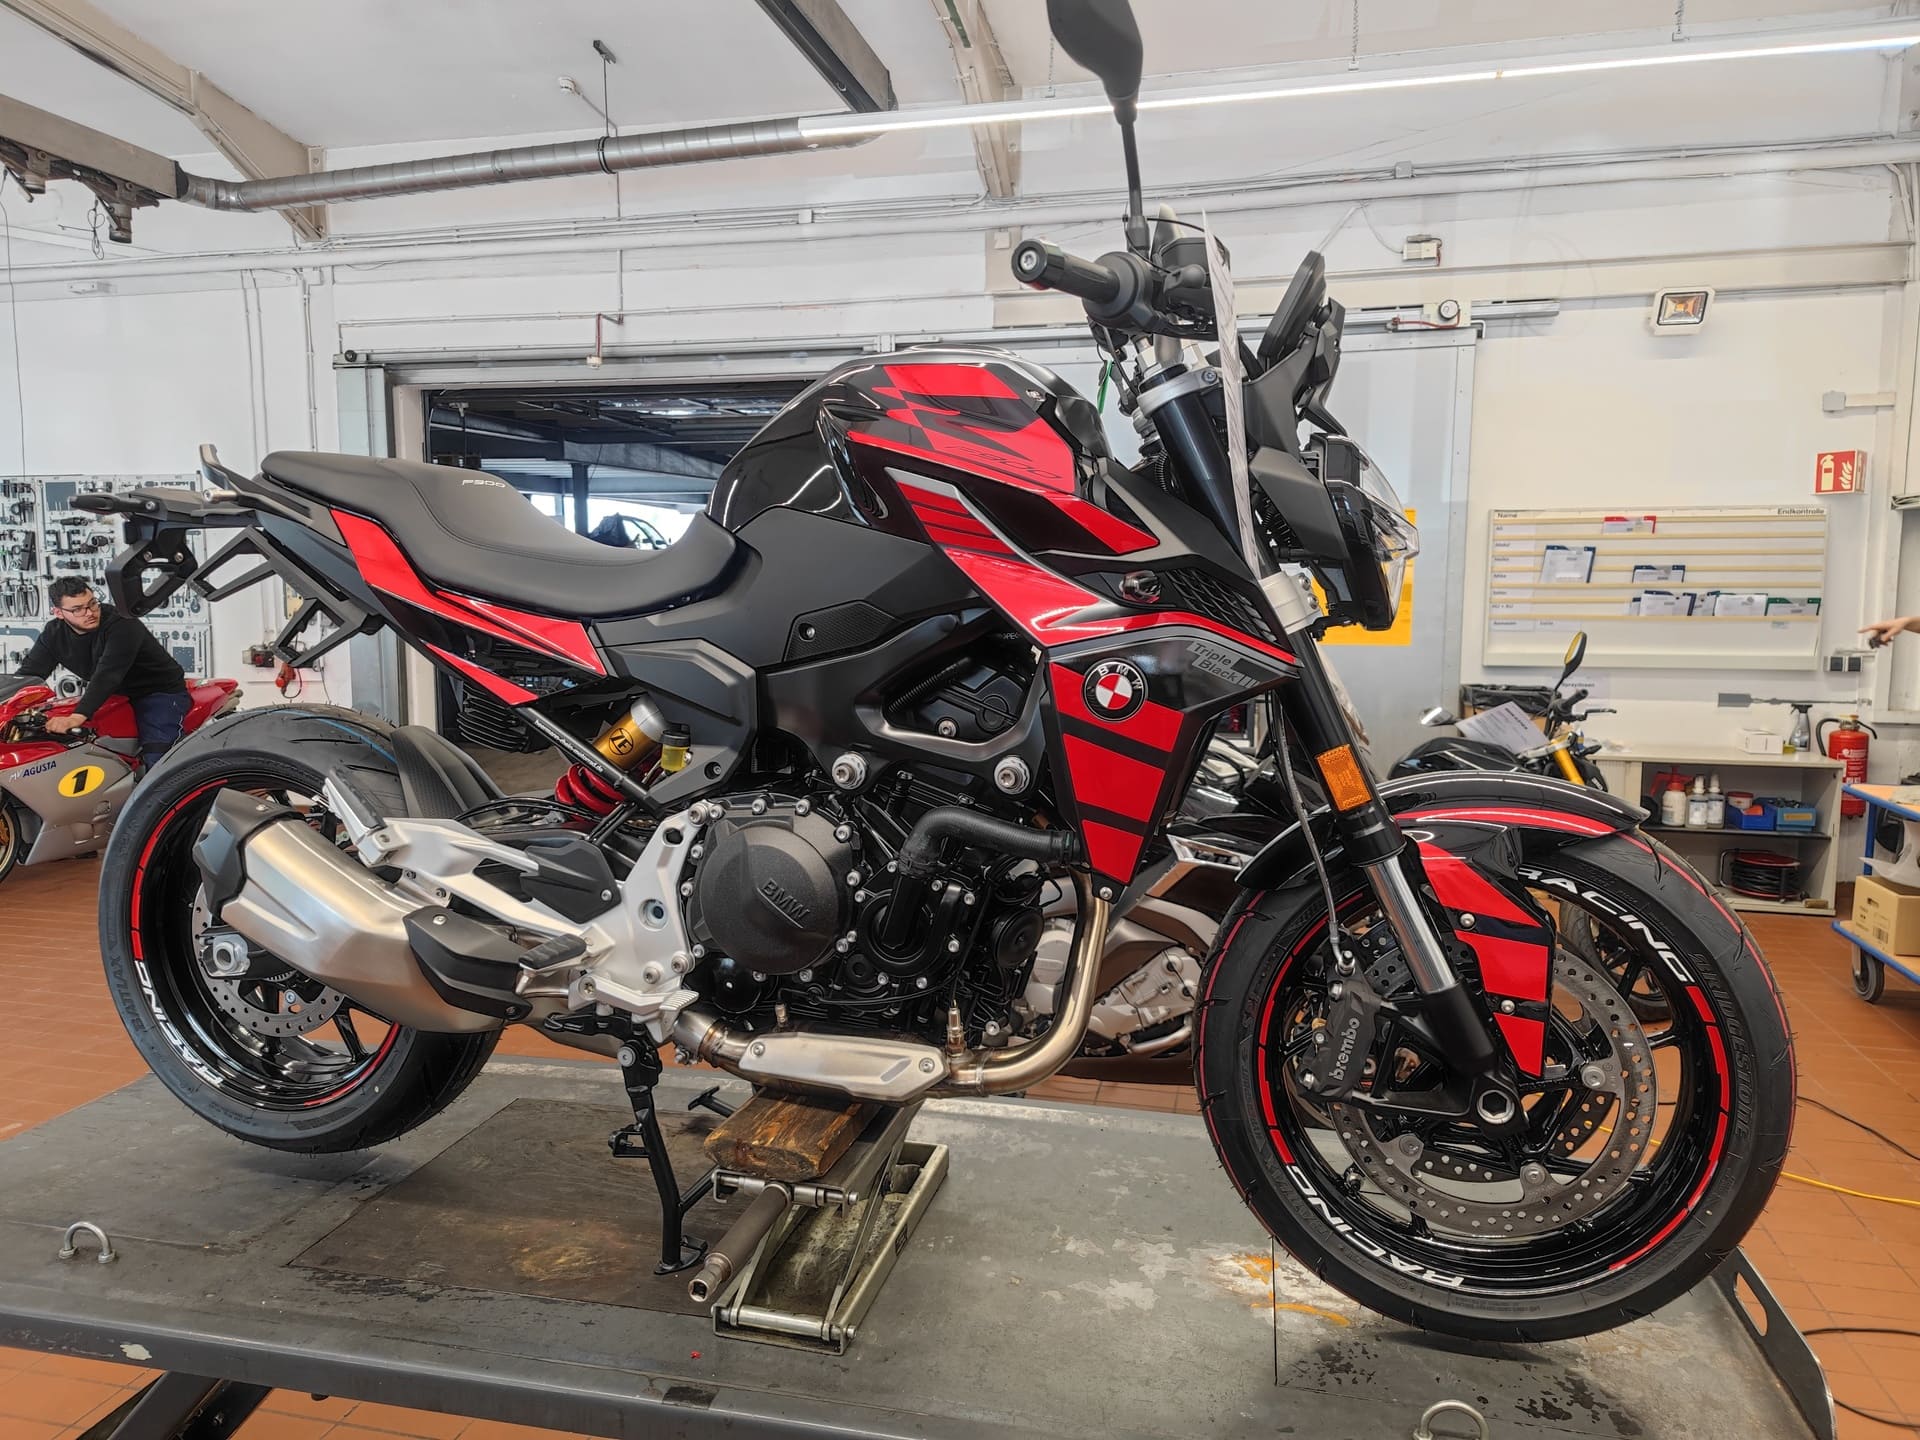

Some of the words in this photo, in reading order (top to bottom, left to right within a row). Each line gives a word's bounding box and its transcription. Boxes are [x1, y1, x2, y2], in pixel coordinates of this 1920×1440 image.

[461, 479, 506, 488] F900
[1194, 644, 1233, 667] Triple
[1097, 663, 1144, 690] BMW
[1199, 660, 1241, 683] Black
[22, 760, 57, 778] AGUSTA
[71, 768, 89, 794] 1
[762, 877, 811, 920] BMW
[134, 959, 224, 1088] RACING
[1328, 1017, 1360, 1081] brembo
[1286, 1165, 1465, 1288] RACING
